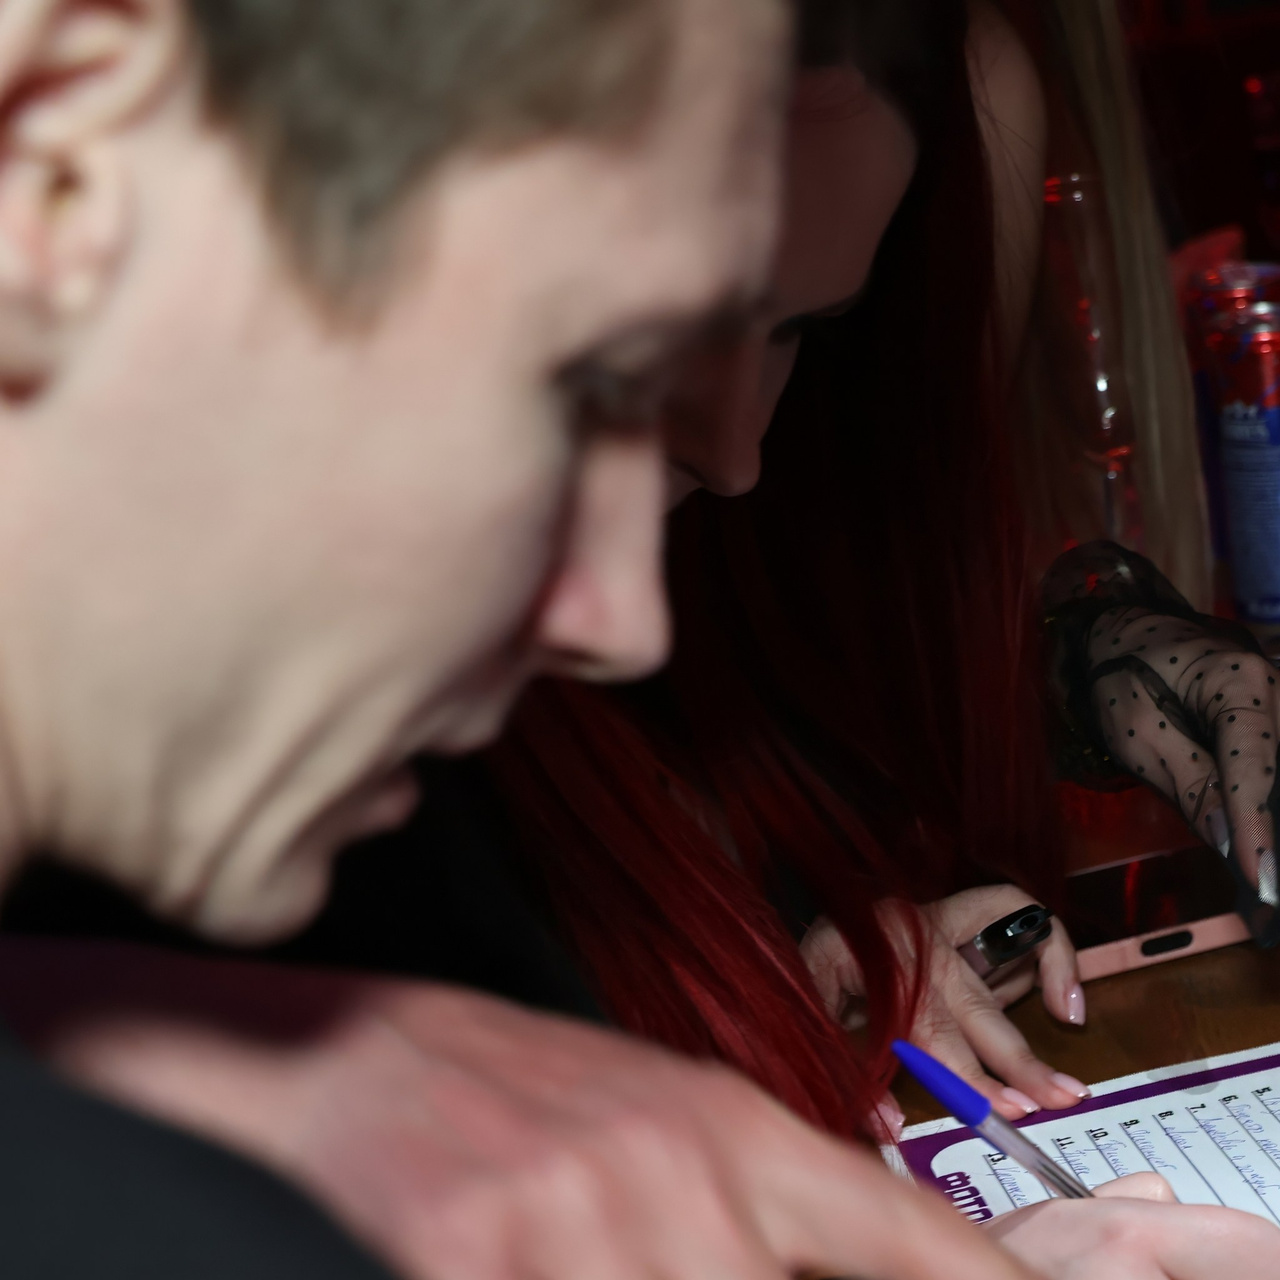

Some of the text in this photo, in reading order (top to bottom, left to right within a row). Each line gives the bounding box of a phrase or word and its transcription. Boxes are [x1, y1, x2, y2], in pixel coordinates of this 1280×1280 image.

[1254, 1086, 1273, 1097] 5.
[1220, 1094, 1240, 1105] 6.
[1189, 1102, 1207, 1114] 7.
[1157, 1110, 1175, 1121] 8.
[1121, 1118, 1141, 1130] 9.
[1087, 1127, 1109, 1142] 10.
[1053, 1136, 1076, 1151] 11.
